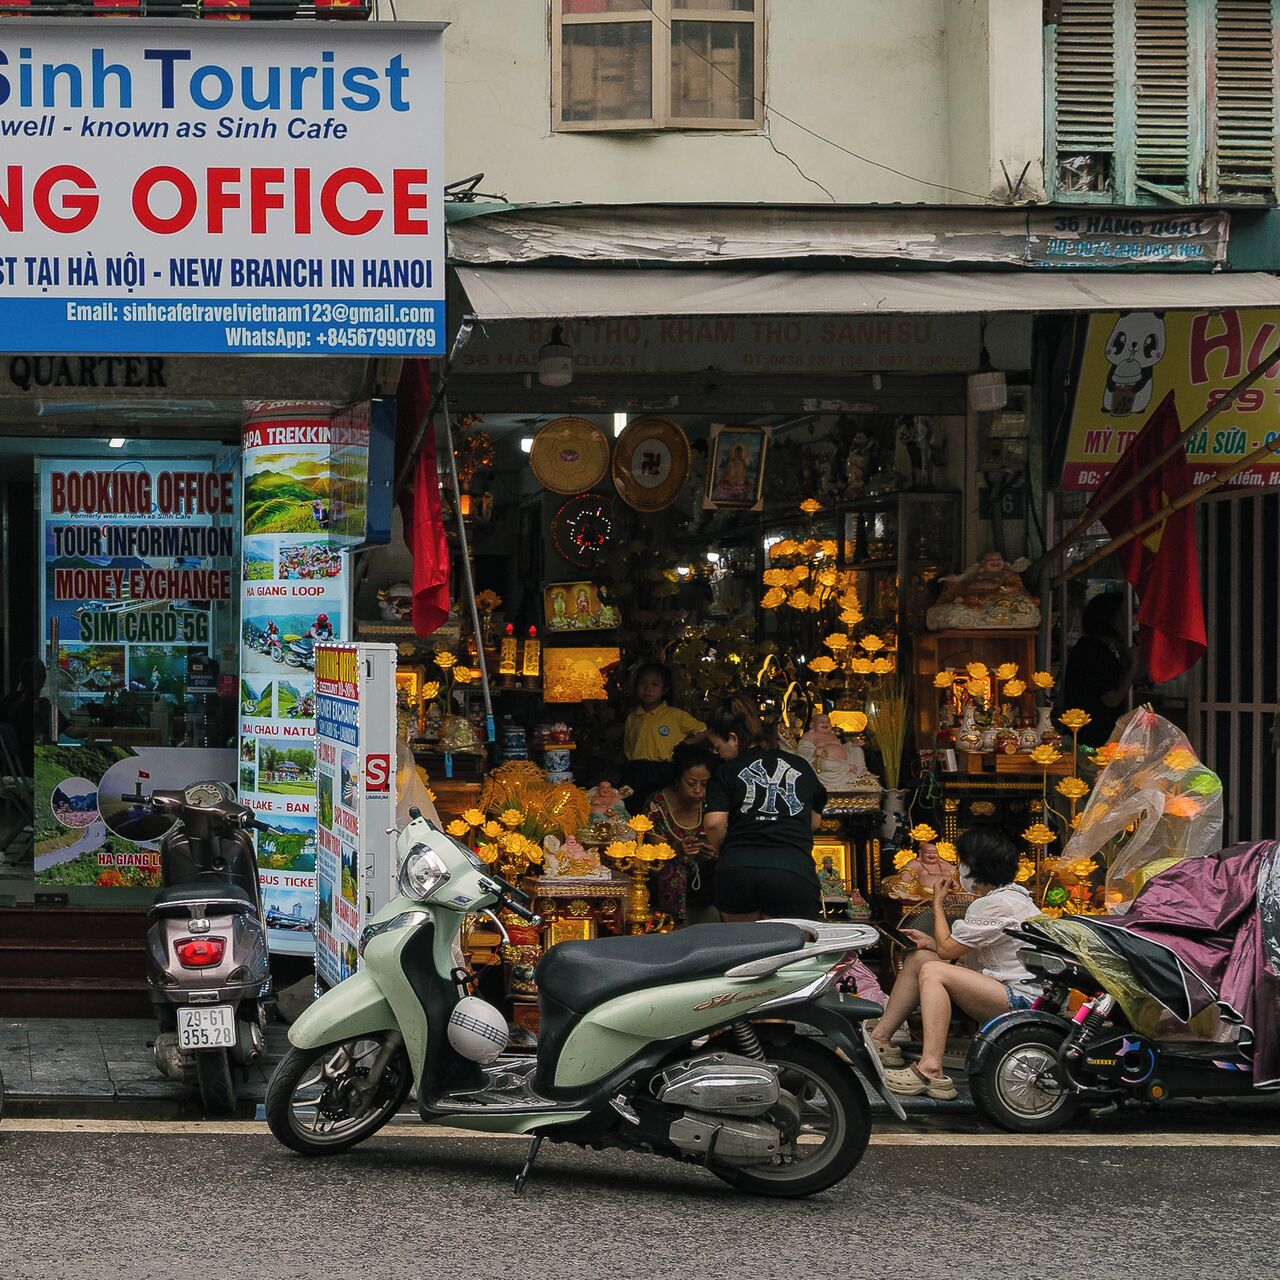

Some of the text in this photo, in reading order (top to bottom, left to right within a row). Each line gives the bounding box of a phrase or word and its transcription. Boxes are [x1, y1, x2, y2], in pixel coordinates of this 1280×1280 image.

[144, 48, 411, 112] Tourist
[1, 116, 54, 138] well
[81, 116, 169, 138] known
[176, 122, 207, 139] as
[217, 117, 277, 139] Sinh
[287, 118, 348, 140] Cafe
[131, 165, 429, 235] OFFICE
[24, 257, 60, 292] TẠI
[68, 251, 99, 288] HÀ
[106, 251, 145, 293] NỘI
[169, 258, 223, 288] NEW
[230, 258, 322, 289] BRANCH
[331, 259, 354, 289] IN
[362, 259, 433, 289] HANOI
[66, 302, 434, 326] Email: sinhcafetravelvietnam123@gmail.com
[225, 327, 436, 349] WhatsApp: +84567990789
[9, 356, 167, 391] QUARTER
[1212, 427, 1247, 455] SỮA
[50, 471, 234, 514] BOOKING OFFICE
[52, 525, 233, 557] TOUR INFORMATION
[55, 569, 231, 600] MONEY EXCHANGE
[257, 587, 287, 597] GIANG
[292, 586, 324, 596] LOOP
[80, 611, 209, 643] SIM CARD 5G
[255, 725, 279, 735] CHAU
[283, 726, 316, 736] NATU
[252, 799, 310, 813] LAKE BAN
[98, 853, 112, 866] HA
[116, 853, 149, 866] GIANG
[260, 875, 279, 886] BUS
[186, 1010, 225, 1028] 29-G1
[183, 1027, 231, 1046] 355.28
